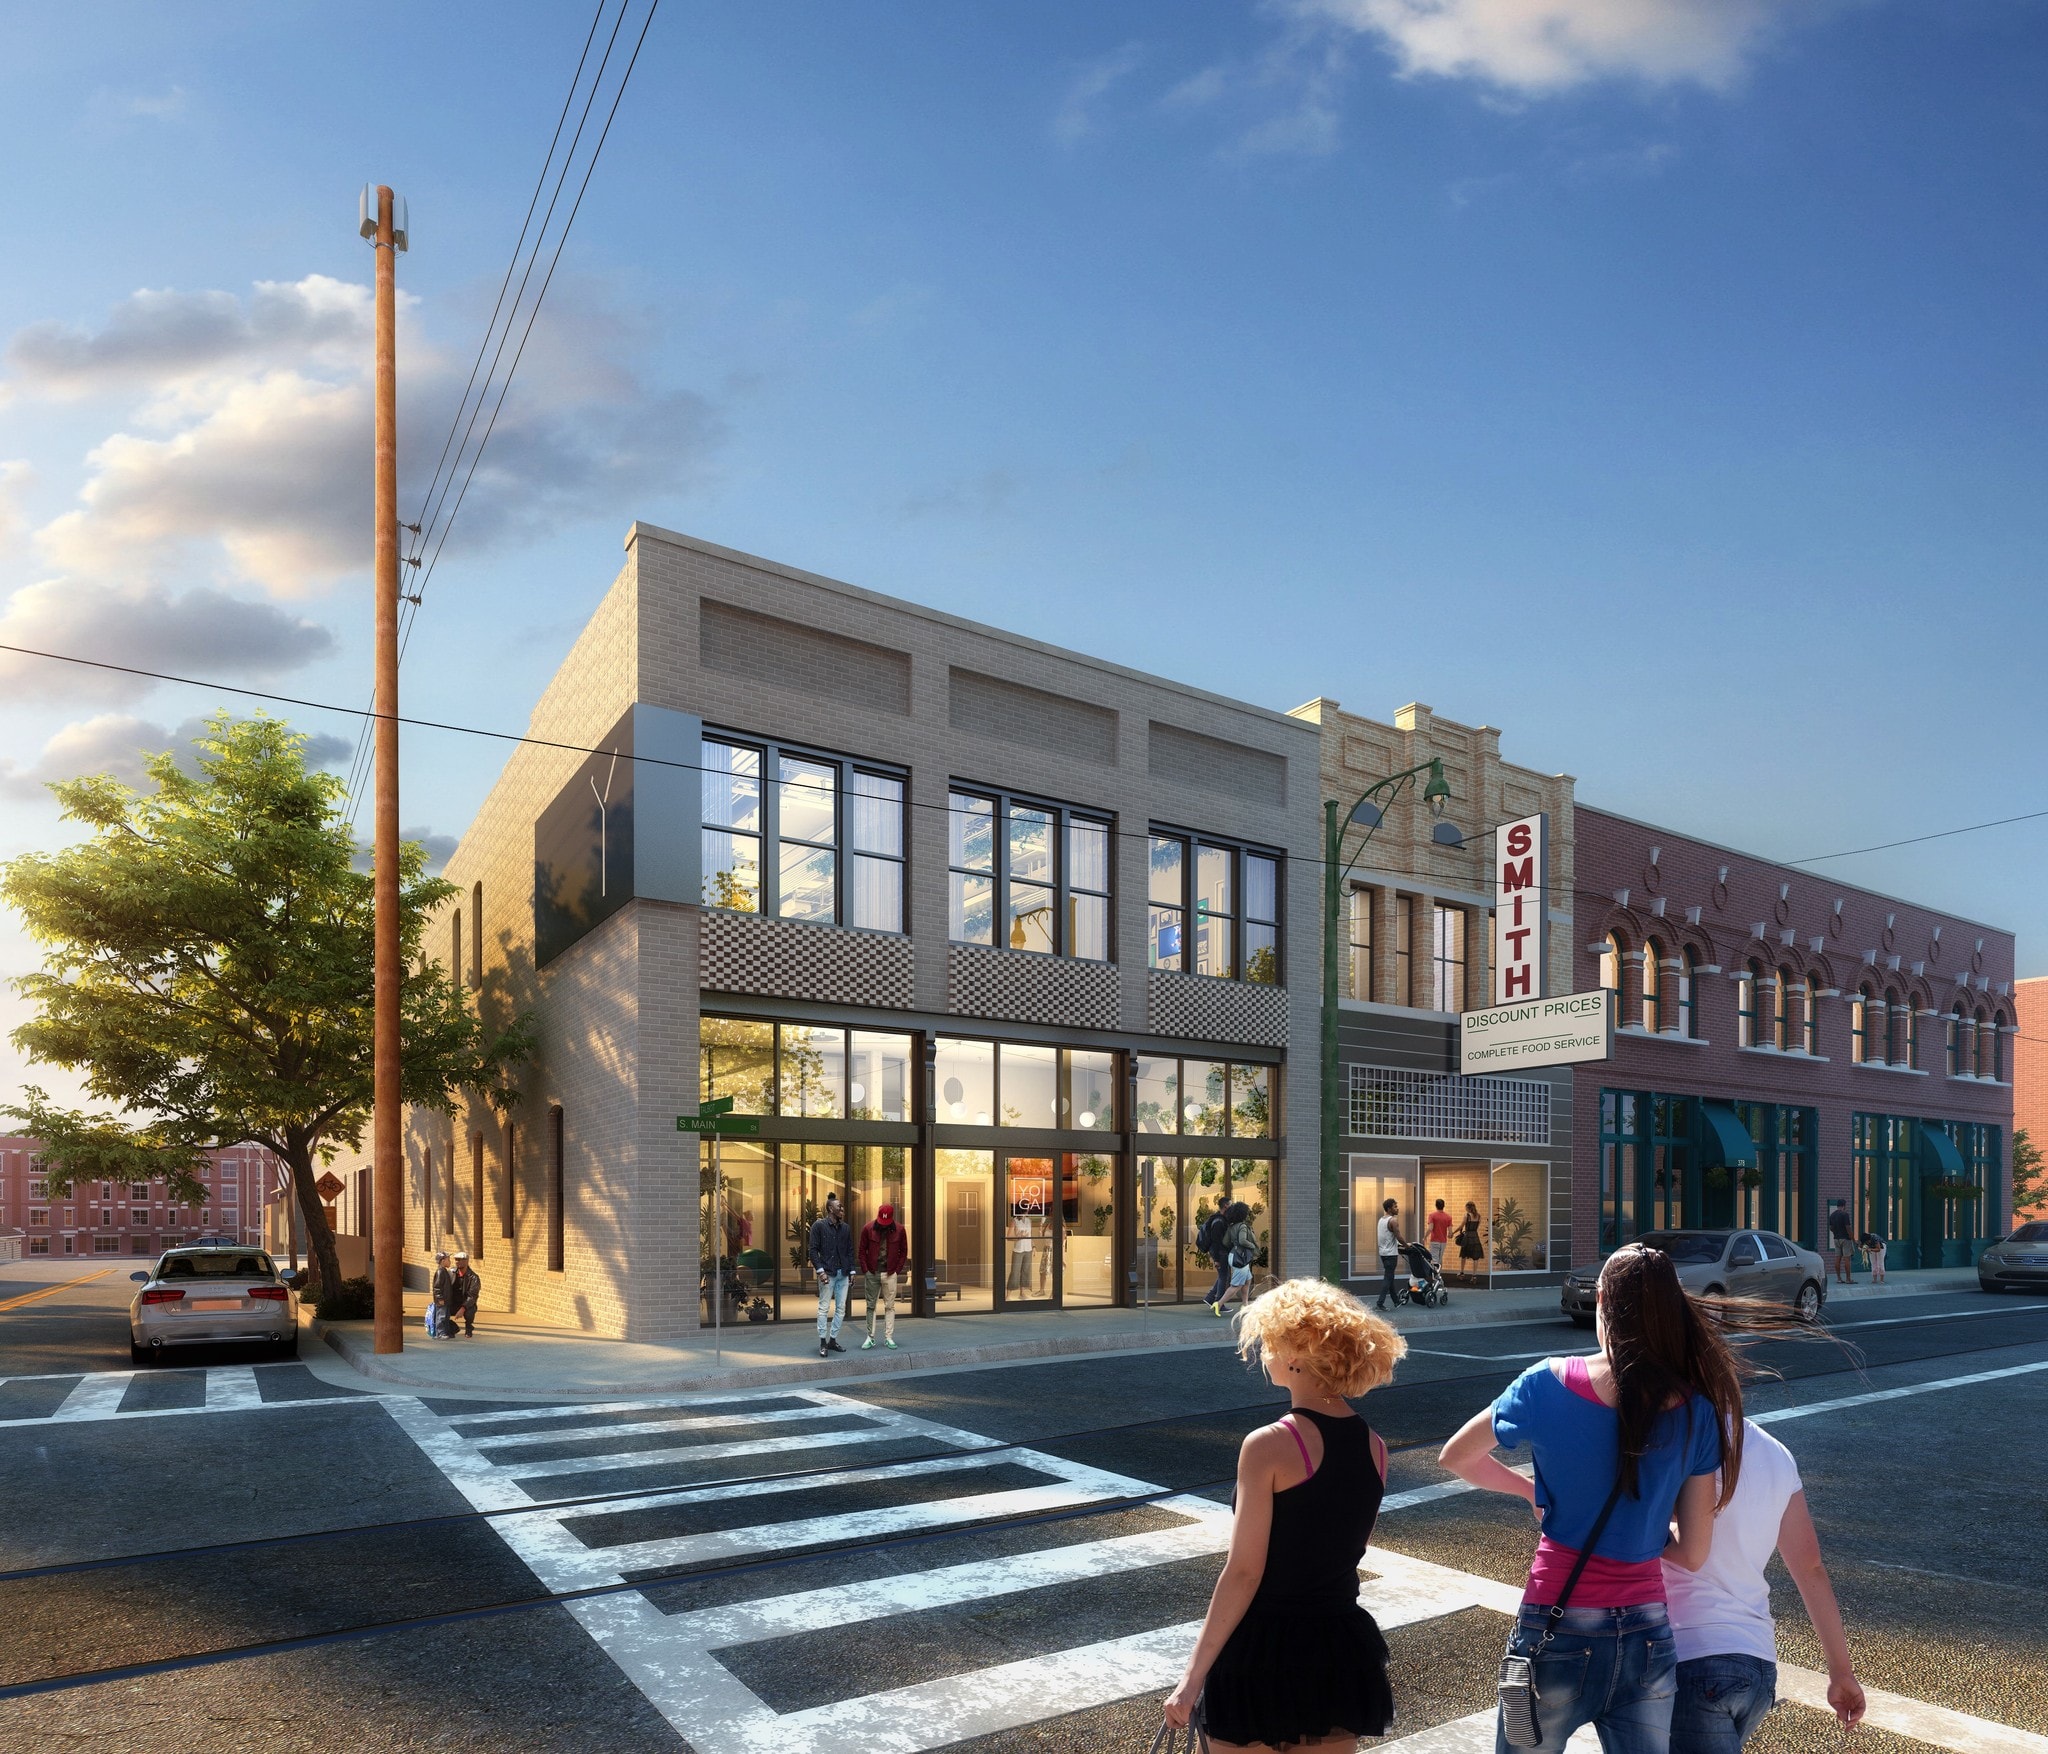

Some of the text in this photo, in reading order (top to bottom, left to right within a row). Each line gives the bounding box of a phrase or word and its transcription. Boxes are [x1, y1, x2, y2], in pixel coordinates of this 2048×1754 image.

[1503, 823, 1534, 999] SMITH
[1466, 996, 1602, 1029] DISCOUNT PRICES
[1467, 1035, 1601, 1061] COMPLETE FOOD SERVICE
[691, 1119, 716, 1130] MAIN
[1018, 1185, 1041, 1197] YO
[1018, 1198, 1041, 1210] GA
